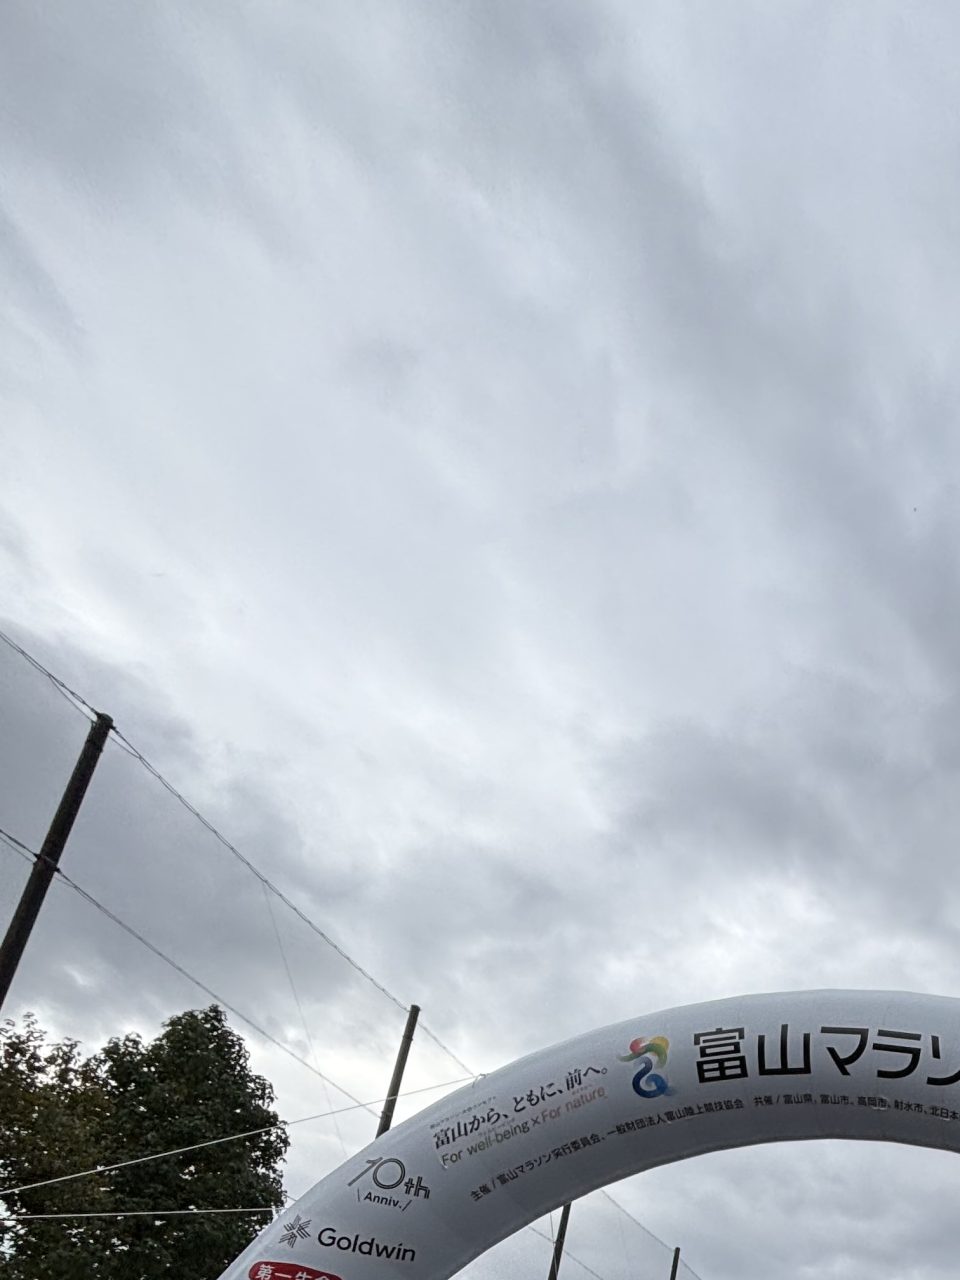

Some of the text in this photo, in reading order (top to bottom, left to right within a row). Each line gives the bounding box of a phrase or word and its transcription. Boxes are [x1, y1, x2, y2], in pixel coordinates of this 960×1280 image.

[442, 1148, 463, 1166] For
[466, 1121, 530, 1156] well-being
[541, 1105, 563, 1123] For
[348, 1157, 431, 1200] 10th
[363, 1191, 403, 1209] Anniv.
[317, 1227, 417, 1262] Goldwin
